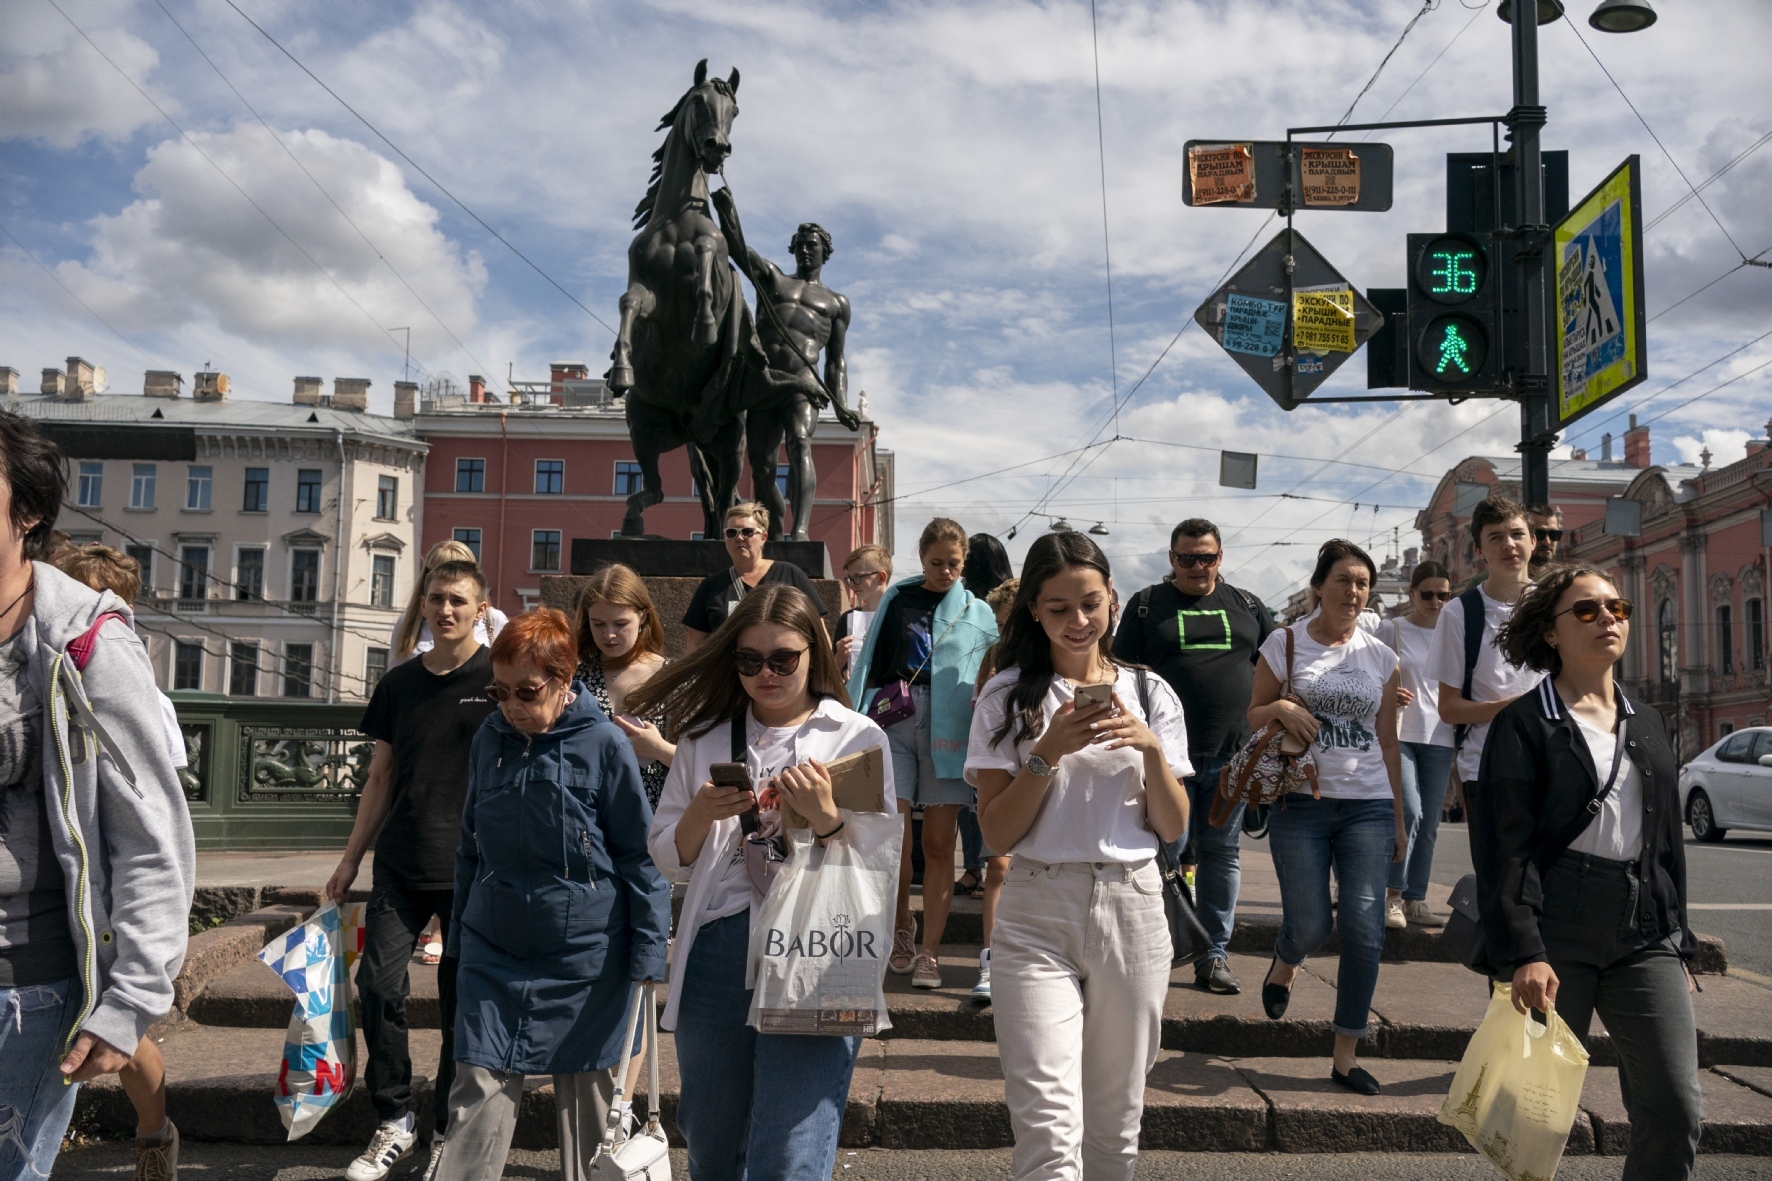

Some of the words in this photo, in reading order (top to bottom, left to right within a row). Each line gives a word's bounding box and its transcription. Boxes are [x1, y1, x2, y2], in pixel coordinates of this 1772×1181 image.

[1233, 152, 1242, 160] ПО
[1304, 151, 1343, 160] ЭКСКУРСИИ
[1197, 161, 1243, 171] КРЫШАМ
[1198, 168, 1244, 178] ПАРАДНЫМ
[1433, 253, 1475, 292] 36
[1231, 298, 1285, 313] КОМБО-ТУР
[1302, 307, 1337, 317] КРЫШИ
[1301, 316, 1351, 327] ПАРАДНЫЕ
[1227, 322, 1253, 332] ДВОРЫ
[1296, 331, 1305, 339] +7
[1305, 332, 1317, 341] 981
[1318, 333, 1331, 343] 755
[1331, 334, 1339, 343] 51
[1340, 335, 1349, 344] 85
[765, 928, 878, 959] BABOR
